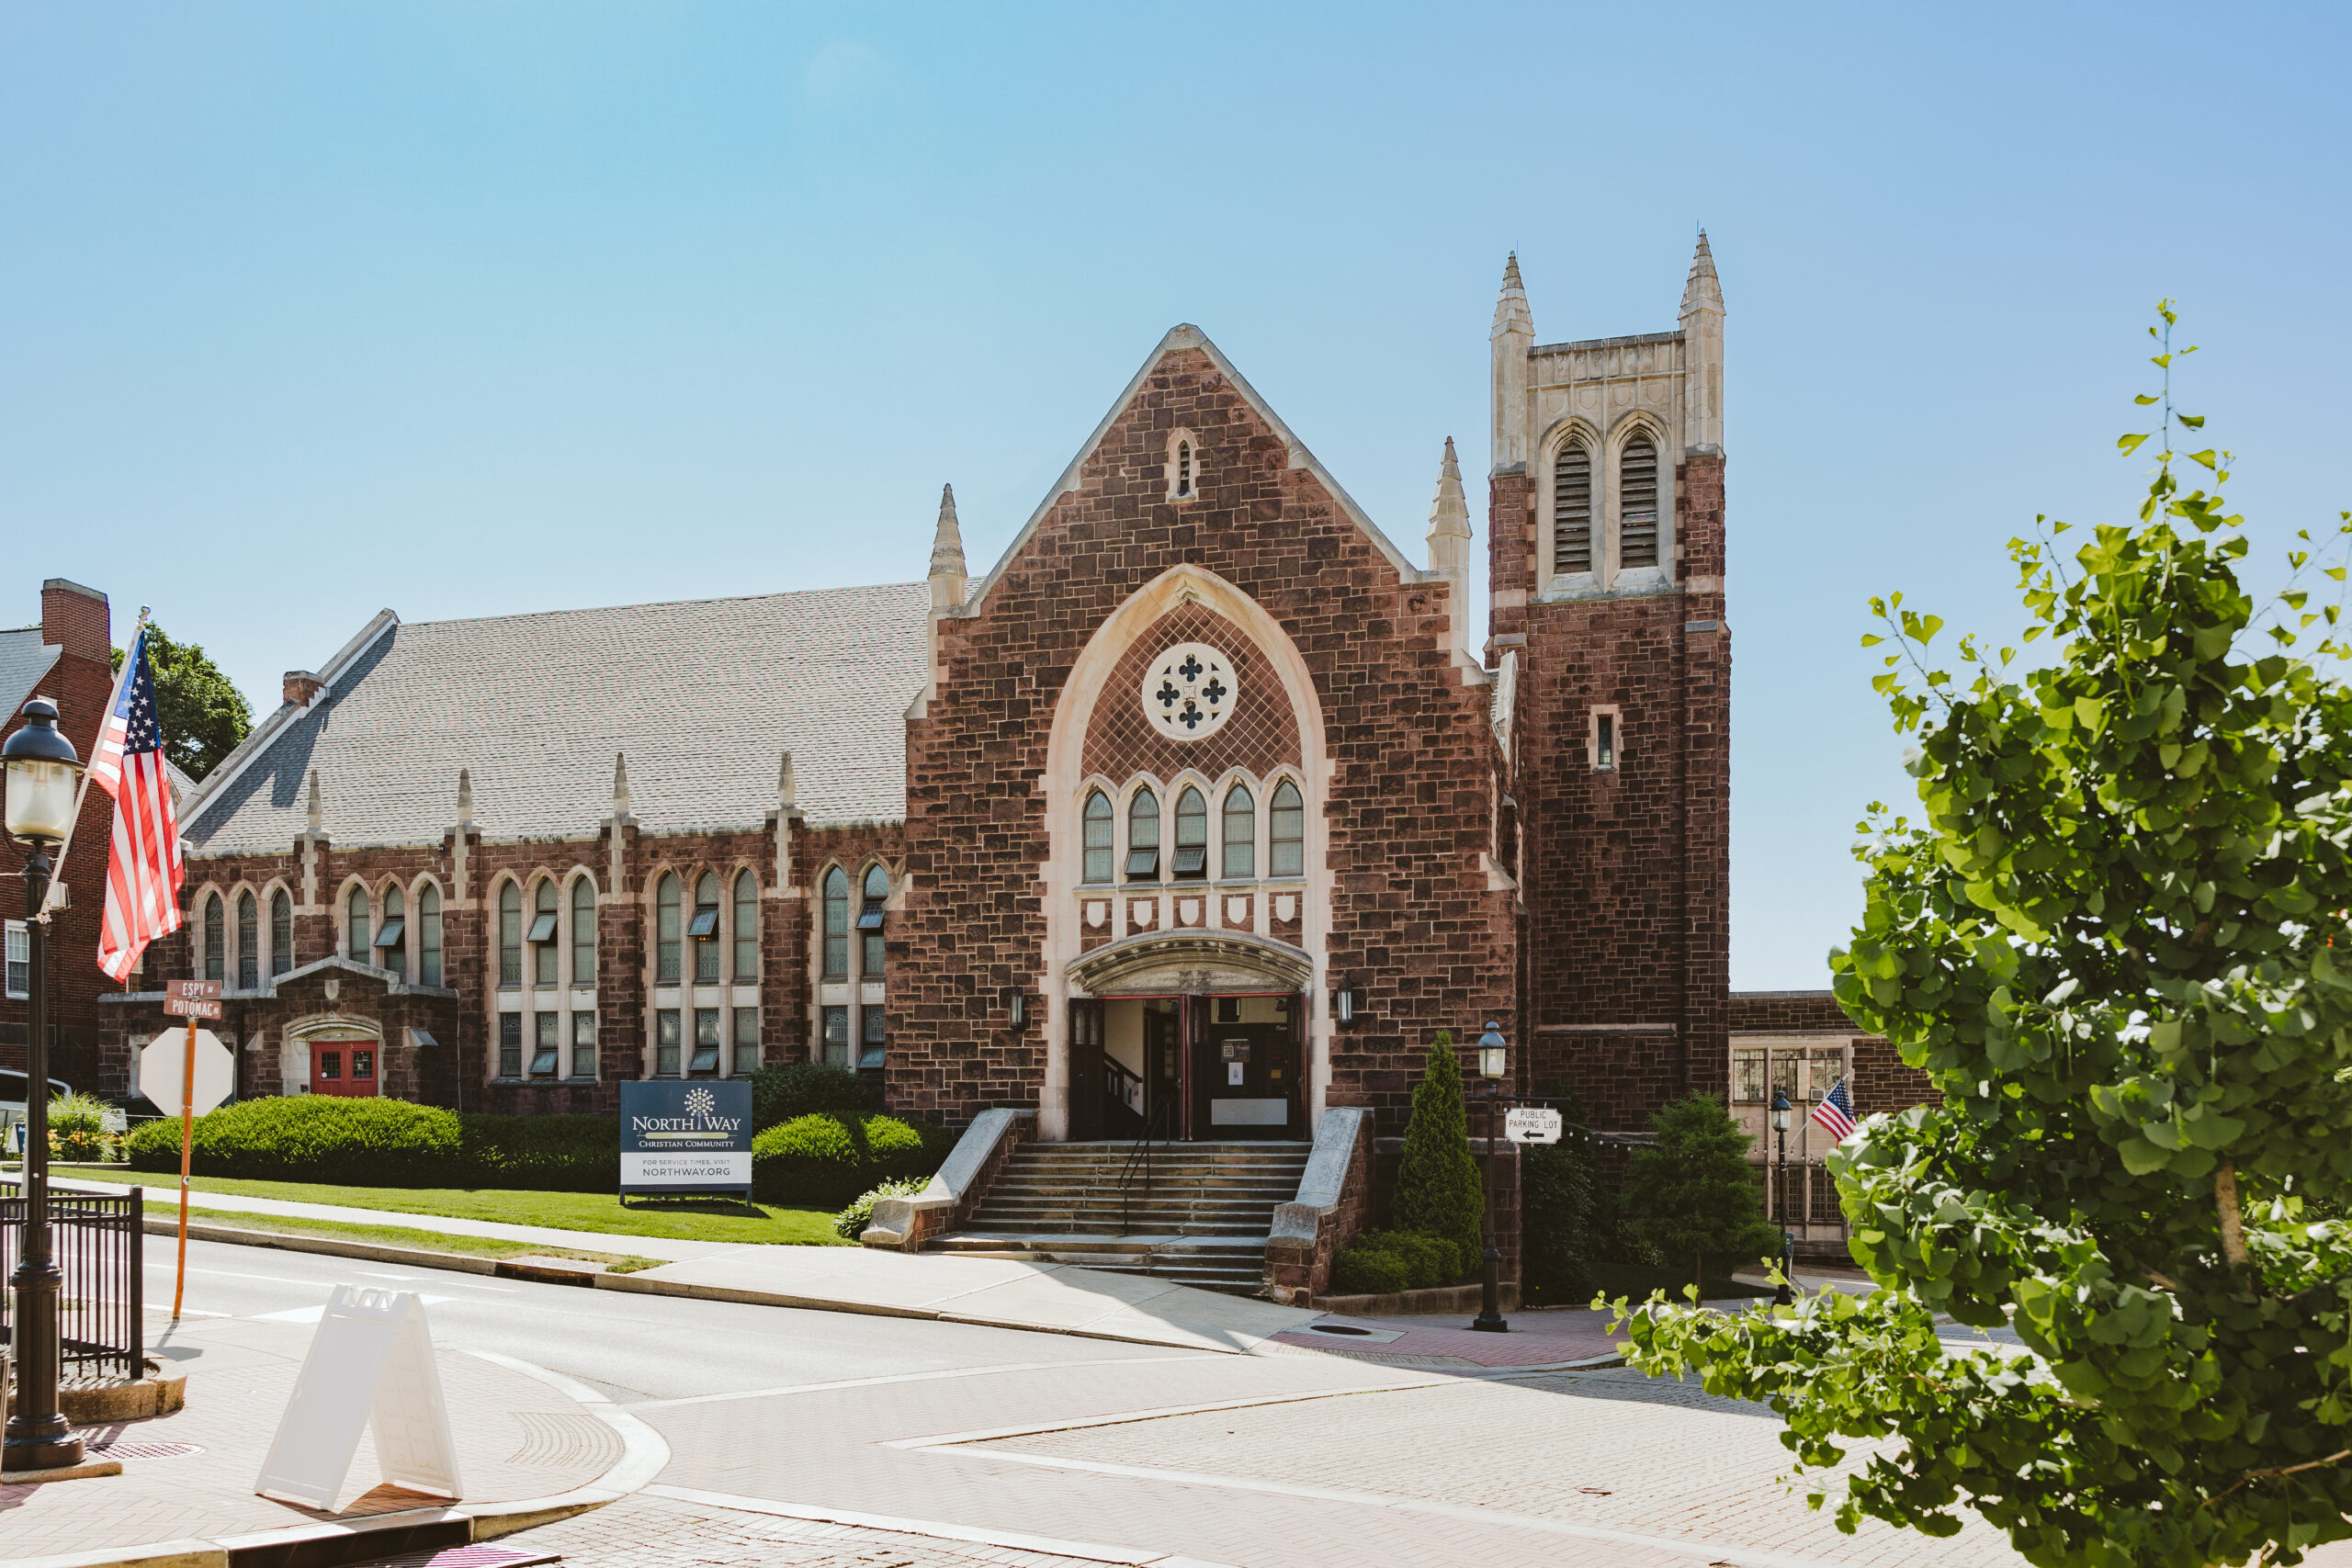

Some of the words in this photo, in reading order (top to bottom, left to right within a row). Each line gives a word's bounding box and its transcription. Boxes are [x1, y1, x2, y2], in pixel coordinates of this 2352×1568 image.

[183, 983, 205, 996] ESPY
[172, 999, 212, 1016] POTOMAC
[1521, 1110, 1546, 1119] PUBLIC
[632, 1116, 694, 1131] NORTH
[704, 1116, 741, 1131] WAY
[1509, 1120, 1539, 1129] PARKING
[1544, 1121, 1557, 1129] LOT
[639, 1140, 683, 1148] CHRISTIAN
[685, 1140, 735, 1148] COMMUNITY
[642, 1168, 730, 1177] NORTHWAY.ORG
